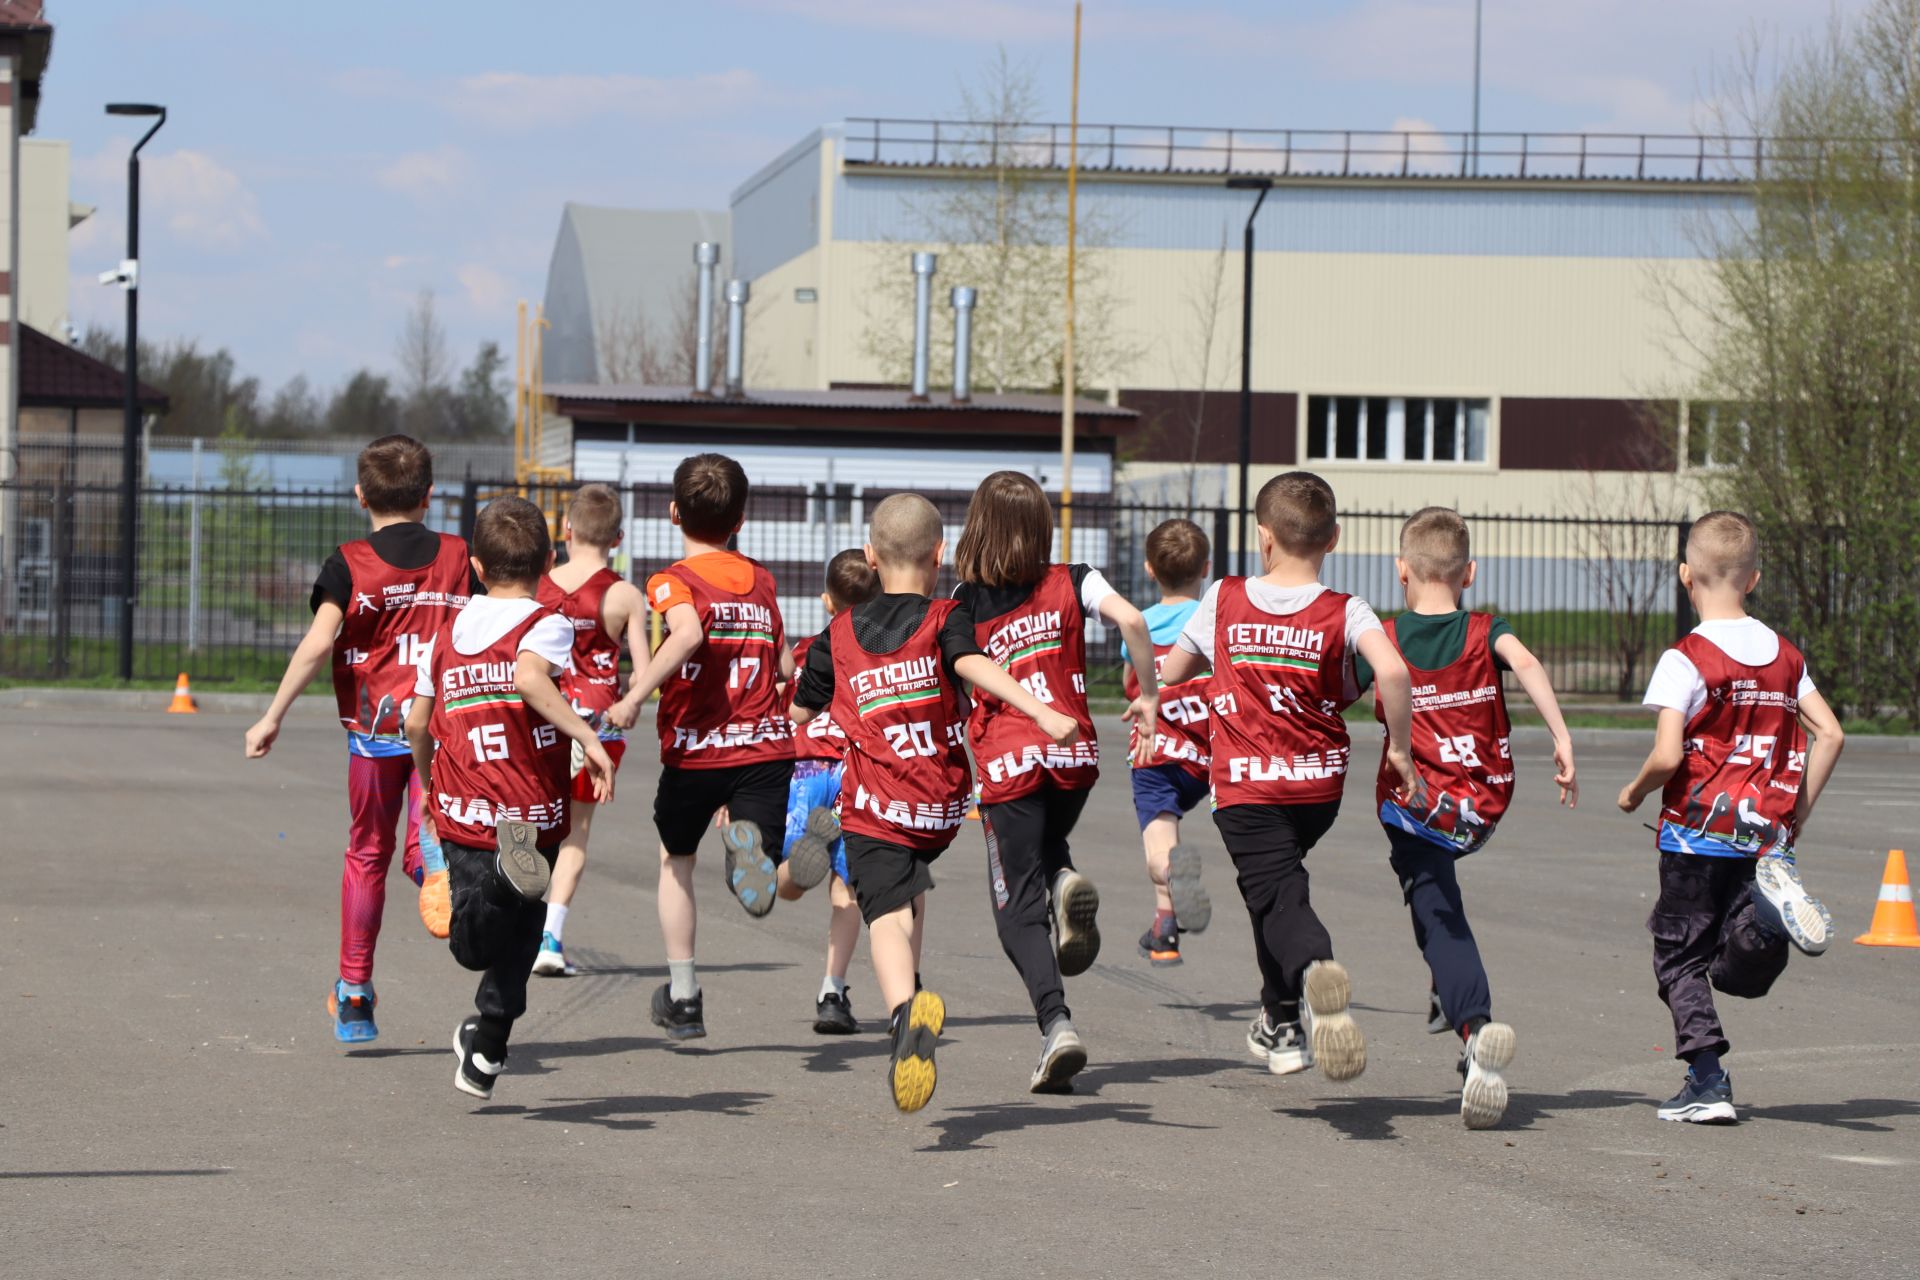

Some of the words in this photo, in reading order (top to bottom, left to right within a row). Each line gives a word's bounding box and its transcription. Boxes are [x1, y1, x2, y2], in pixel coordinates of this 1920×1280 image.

[1227, 623, 1325, 652] ТЕТЮШИ
[1228, 644, 1274, 655] РЕСПУБЛИКА
[1275, 646, 1321, 660] ТАТАРСТАН
[729, 657, 760, 690] 17
[1161, 695, 1210, 726] 90
[1214, 692, 1238, 717] 21
[467, 723, 509, 763] 15
[532, 724, 557, 750] 15
[883, 720, 938, 760] 20
[1434, 733, 1482, 768] 28
[1726, 735, 1778, 770] 29
